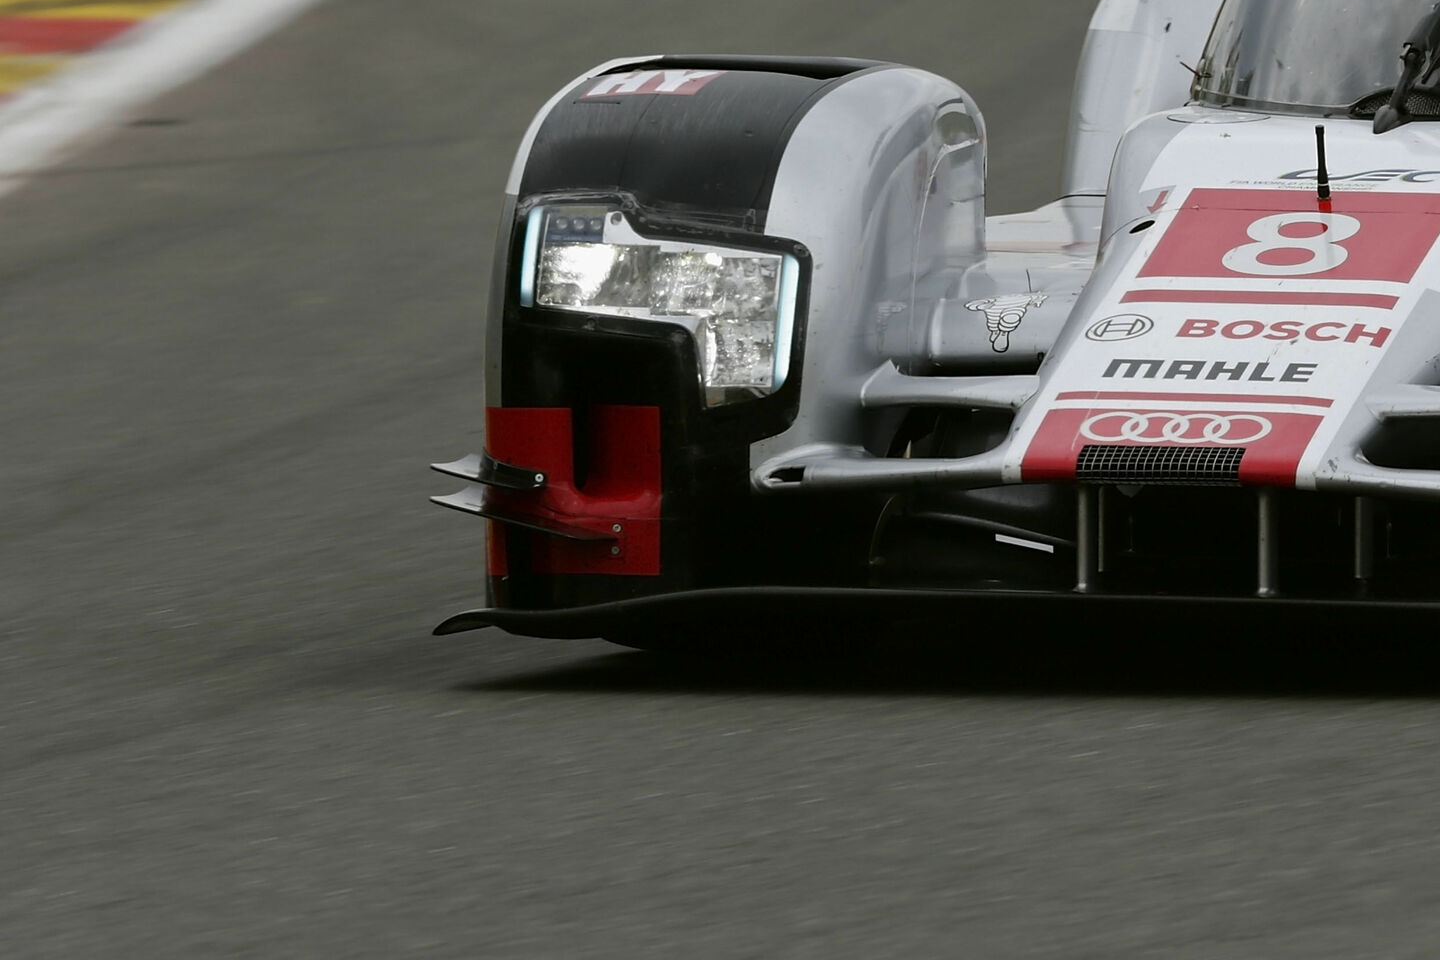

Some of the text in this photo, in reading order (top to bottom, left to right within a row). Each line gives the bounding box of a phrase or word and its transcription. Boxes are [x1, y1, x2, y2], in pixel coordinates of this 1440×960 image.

[586, 70, 722, 97] HY
[1221, 211, 1361, 276] 8
[1176, 318, 1392, 348] BOSCH
[1101, 358, 1319, 383] MAHLE
